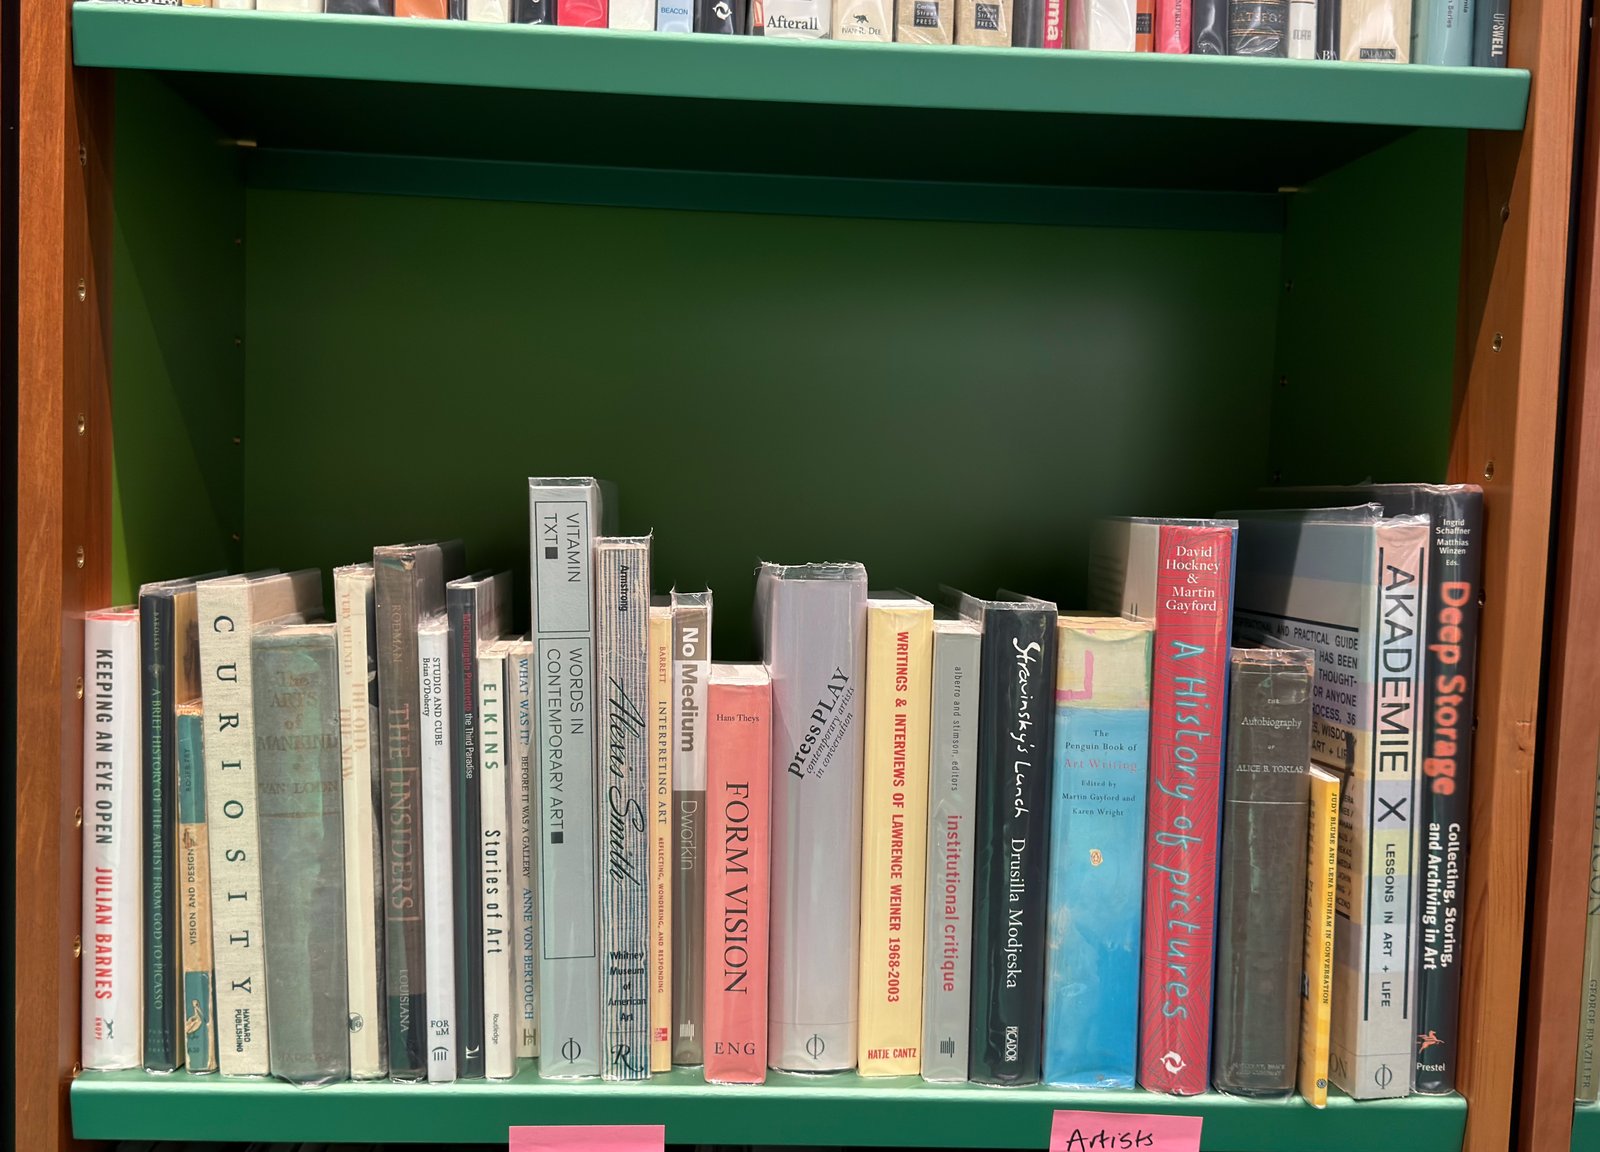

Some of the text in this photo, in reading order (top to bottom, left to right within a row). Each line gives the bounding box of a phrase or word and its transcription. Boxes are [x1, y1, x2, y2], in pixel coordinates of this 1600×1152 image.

[661, 7, 688, 15] BEACON
[767, 15, 819, 31] Afterall
[1447, 6, 1455, 28] Series
[1491, 13, 1505, 57] UPSWELL
[1362, 49, 1395, 59] PALADIN
[1435, 527, 1471, 535] Schaffner
[1443, 519, 1465, 528] Ingrid
[566, 512, 581, 582] VITAMIN
[1176, 546, 1212, 557] David
[1436, 538, 1469, 547] Matthias
[1439, 547, 1466, 555] Winzen
[1165, 559, 1221, 574] Hockney
[1187, 573, 1199, 584] &
[618, 564, 630, 612] Armstrong
[1172, 586, 1215, 598] Martin
[1165, 599, 1217, 614] Gayford
[462, 612, 472, 670] Michelangelo
[1293, 627, 1359, 650] PRACTICAL GUIDE
[422, 657, 431, 678] Brian
[1337, 654, 1358, 670] BEEN
[569, 648, 584, 734] WORDS IN
[1318, 668, 1358, 687] THOUGHT-
[1423, 581, 1471, 797] Deep Storage
[432, 657, 443, 747] STUDIO AND CUBE
[1325, 687, 1357, 708] ANYONE
[1378, 565, 1415, 823] AKADEMIE X
[465, 712, 473, 726] the
[483, 683, 499, 770] ELKINS
[716, 713, 760, 723] Hans Theys
[806, 687, 855, 775] contemporary artists
[951, 666, 962, 792] alberro and editors
[1241, 716, 1303, 730] Autobiography
[1345, 712, 1357, 726] 36
[465, 726, 474, 746] Third
[547, 648, 563, 828] CONTEMPORARY ART
[658, 646, 667, 825] BARRETT INTERPRETING ART
[824, 712, 854, 768] conversation
[1065, 742, 1138, 752] Penguin Book of
[1093, 729, 1109, 738] The
[465, 747, 474, 779] Paradise
[681, 627, 699, 871] No Medium Dworkin
[1064, 757, 1085, 769] Art
[608, 676, 646, 886] Alexis Smith
[1081, 779, 1106, 788] Edited
[1236, 764, 1304, 775] ALICE TOKLAS
[213, 615, 252, 993] CURIOSITY
[388, 703, 414, 909] THE INSIDERS
[1062, 792, 1136, 804] Martin Gayford and
[95, 649, 113, 1000] KEEPING AN EYE OPEN JULIAN BARNES
[887, 631, 909, 1003] WRITINGS & INTERVIEWS OF LAWRENCE WEINER 1968-2003
[1004, 637, 1041, 989] Stravinsky's Lunch Drusilla Modjeska
[1072, 807, 1125, 818] Karen Wright
[519, 658, 534, 1020] WHAT WAS BEFORE GALLERY ANNE VON BERTOUCH
[1151, 640, 1211, 1020] A History of pictures
[152, 699, 164, 1009] BRIEF HISTORY THE ARTIST FROM GOD TO PICASSO
[187, 848, 197, 945] VISION AND DESIGN
[485, 829, 502, 954] Stories of Art
[724, 781, 749, 995] FORM VISION
[1422, 822, 1442, 970] and Archiving in Art
[1440, 822, 1460, 968] Collecting, Storing,
[940, 815, 962, 993] institutional critique
[1381, 843, 1396, 1008] LESSONS IN ART LIFE
[609, 951, 645, 964] Whitney
[1322, 891, 1333, 1005] DUNHAM CONVERSATION
[609, 965, 645, 976] Museum
[399, 969, 410, 1033] LOUISIANA
[608, 996, 647, 1006] American
[235, 1009, 243, 1053] PUBLISHING
[1005, 1026, 1018, 1062] PICADOR
[1583, 979, 1598, 1089] GEORGE BRAZILLER
[715, 1041, 756, 1056] ENG
[867, 1048, 917, 1060] HATJE CANTZ
[1416, 1062, 1446, 1072] Prestel
[1066, 1128, 1154, 1152] Artists
